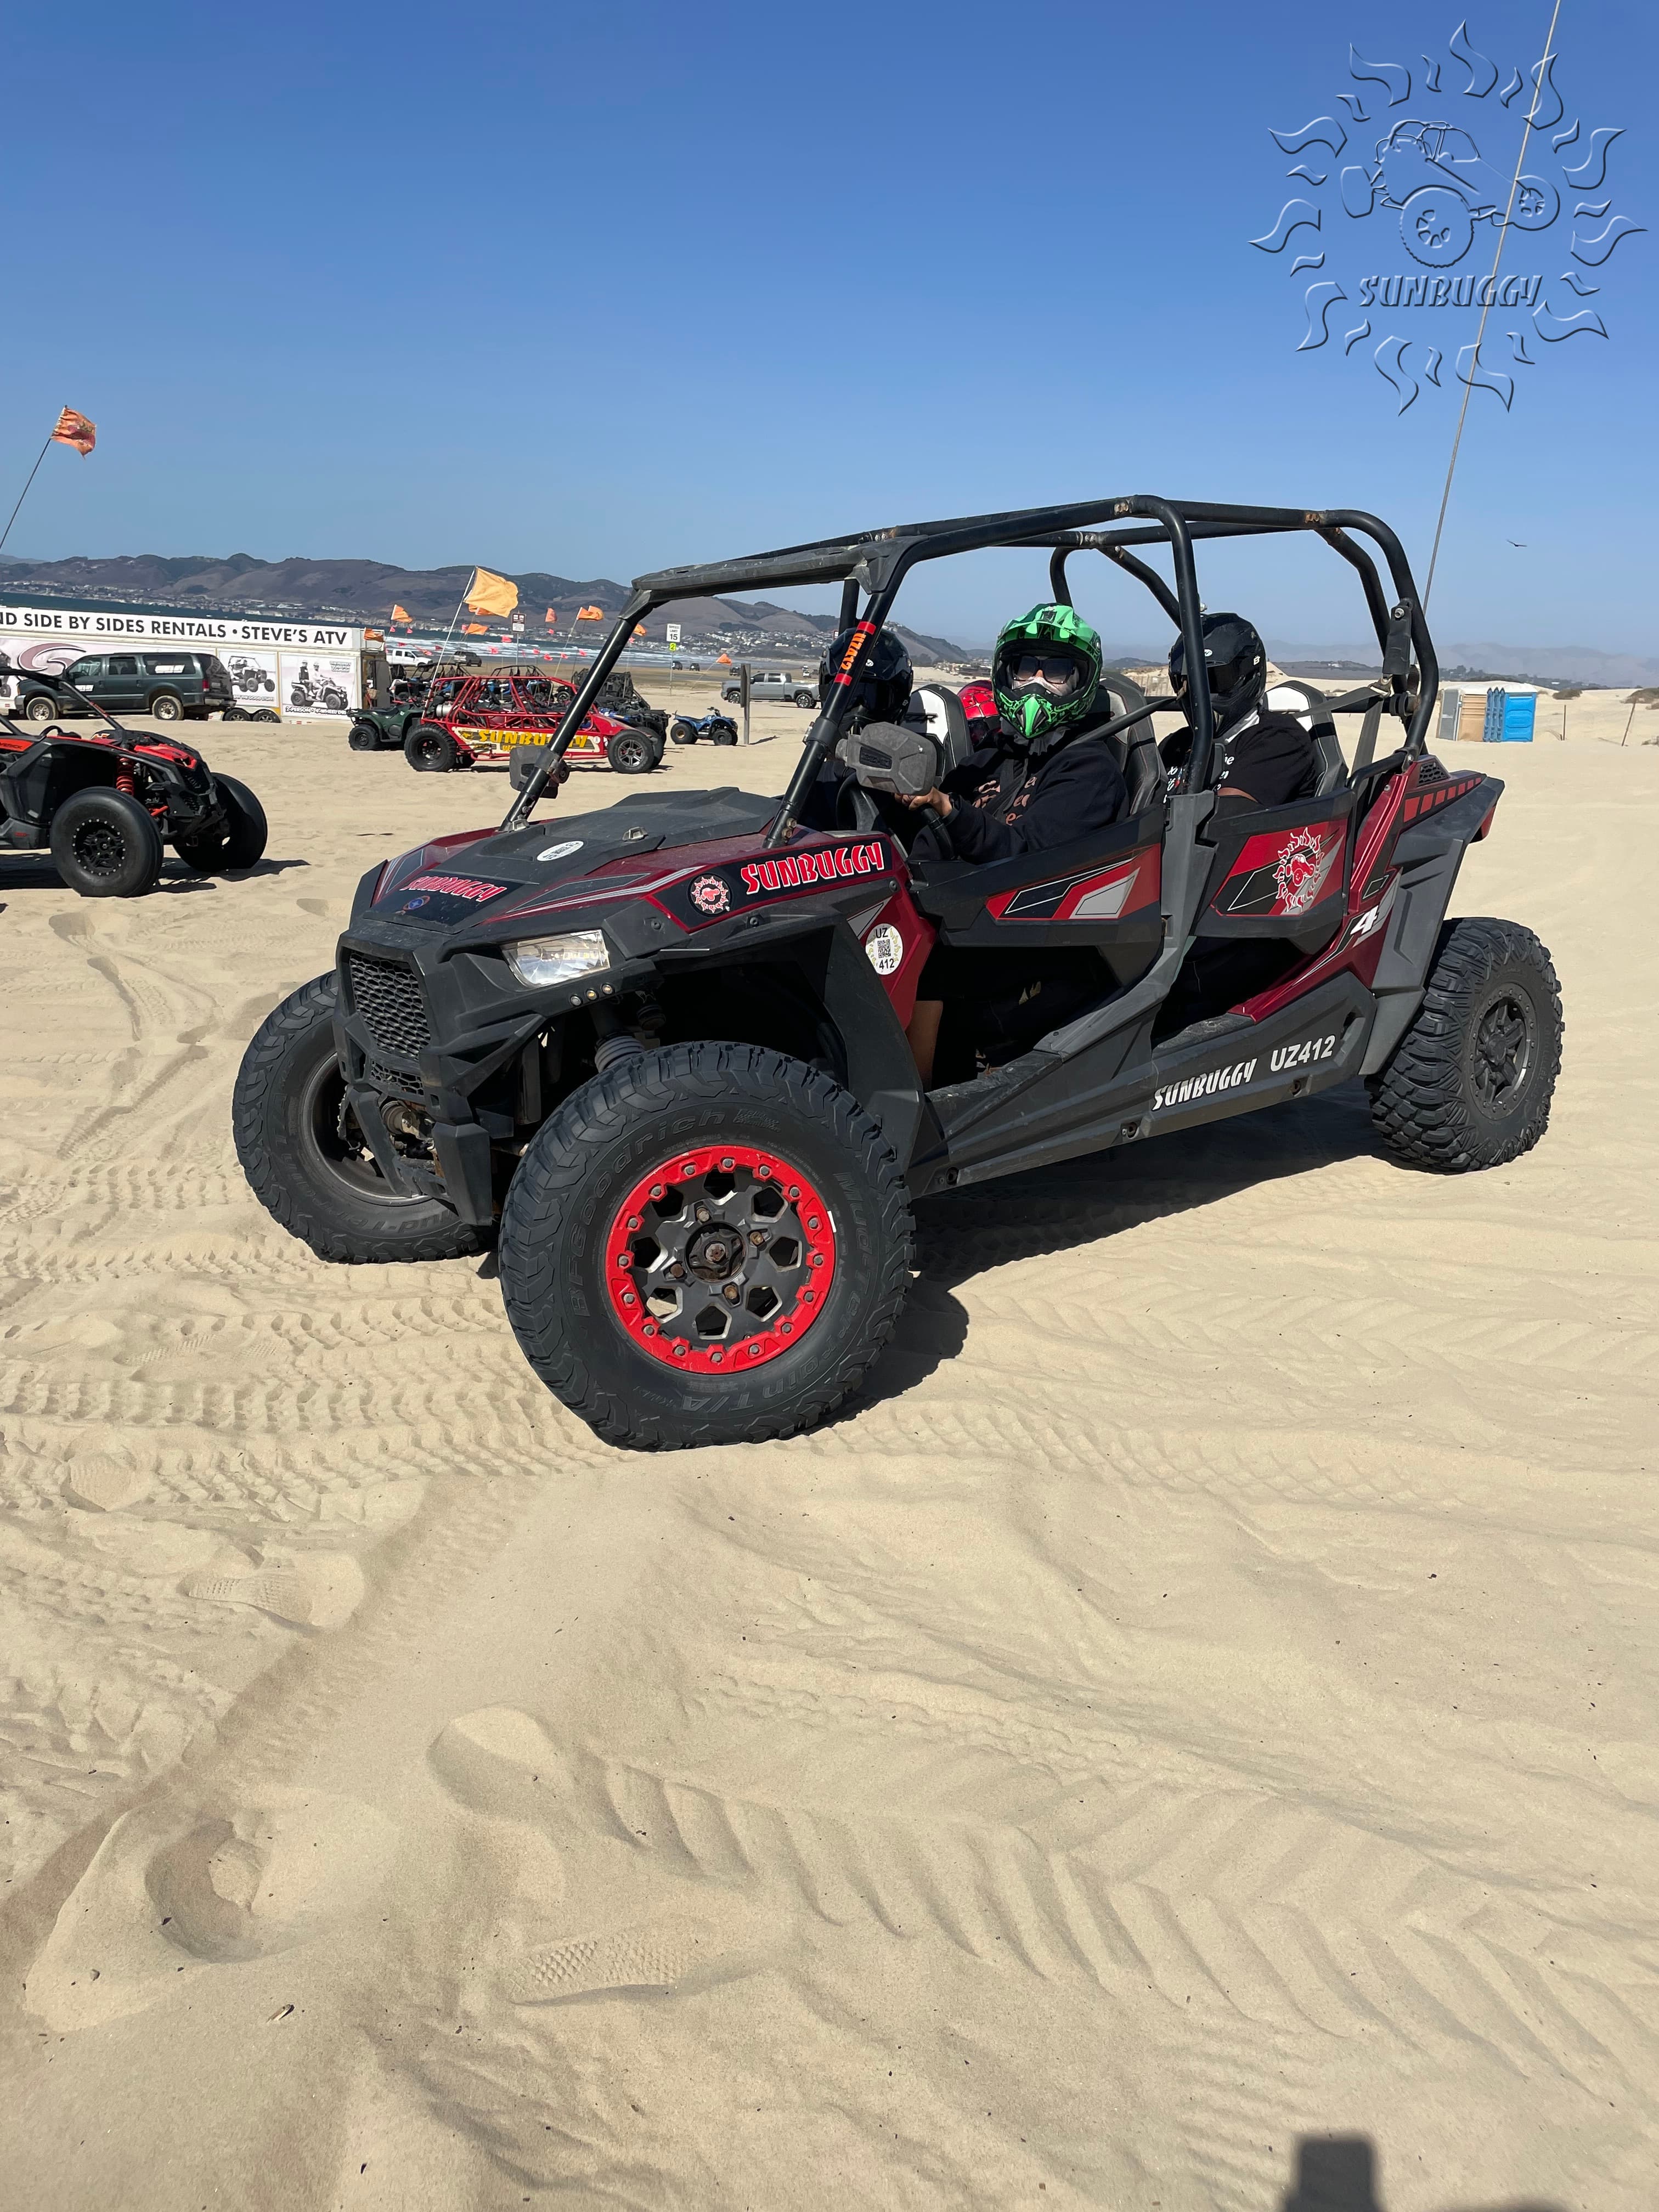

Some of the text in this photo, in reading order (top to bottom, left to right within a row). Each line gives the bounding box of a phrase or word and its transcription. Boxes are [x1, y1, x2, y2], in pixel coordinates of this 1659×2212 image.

[24, 613, 62, 628] SIDE
[69, 616, 90, 630] BY
[96, 617, 145, 633] SIDES
[151, 620, 227, 638] RENTALS
[241, 625, 308, 643] STEVE'S
[313, 630, 347, 645] ATV
[741, 842, 884, 895] SUNBUGGY
[399, 876, 508, 902] SUNBUGGY
[874, 927, 889, 939] UZ
[1350, 905, 1379, 935] 4
[879, 958, 895, 970] 412
[1152, 1035, 1336, 1111] SUNBUGGY UZ412
[567, 1109, 726, 1317] BFGoodrich
